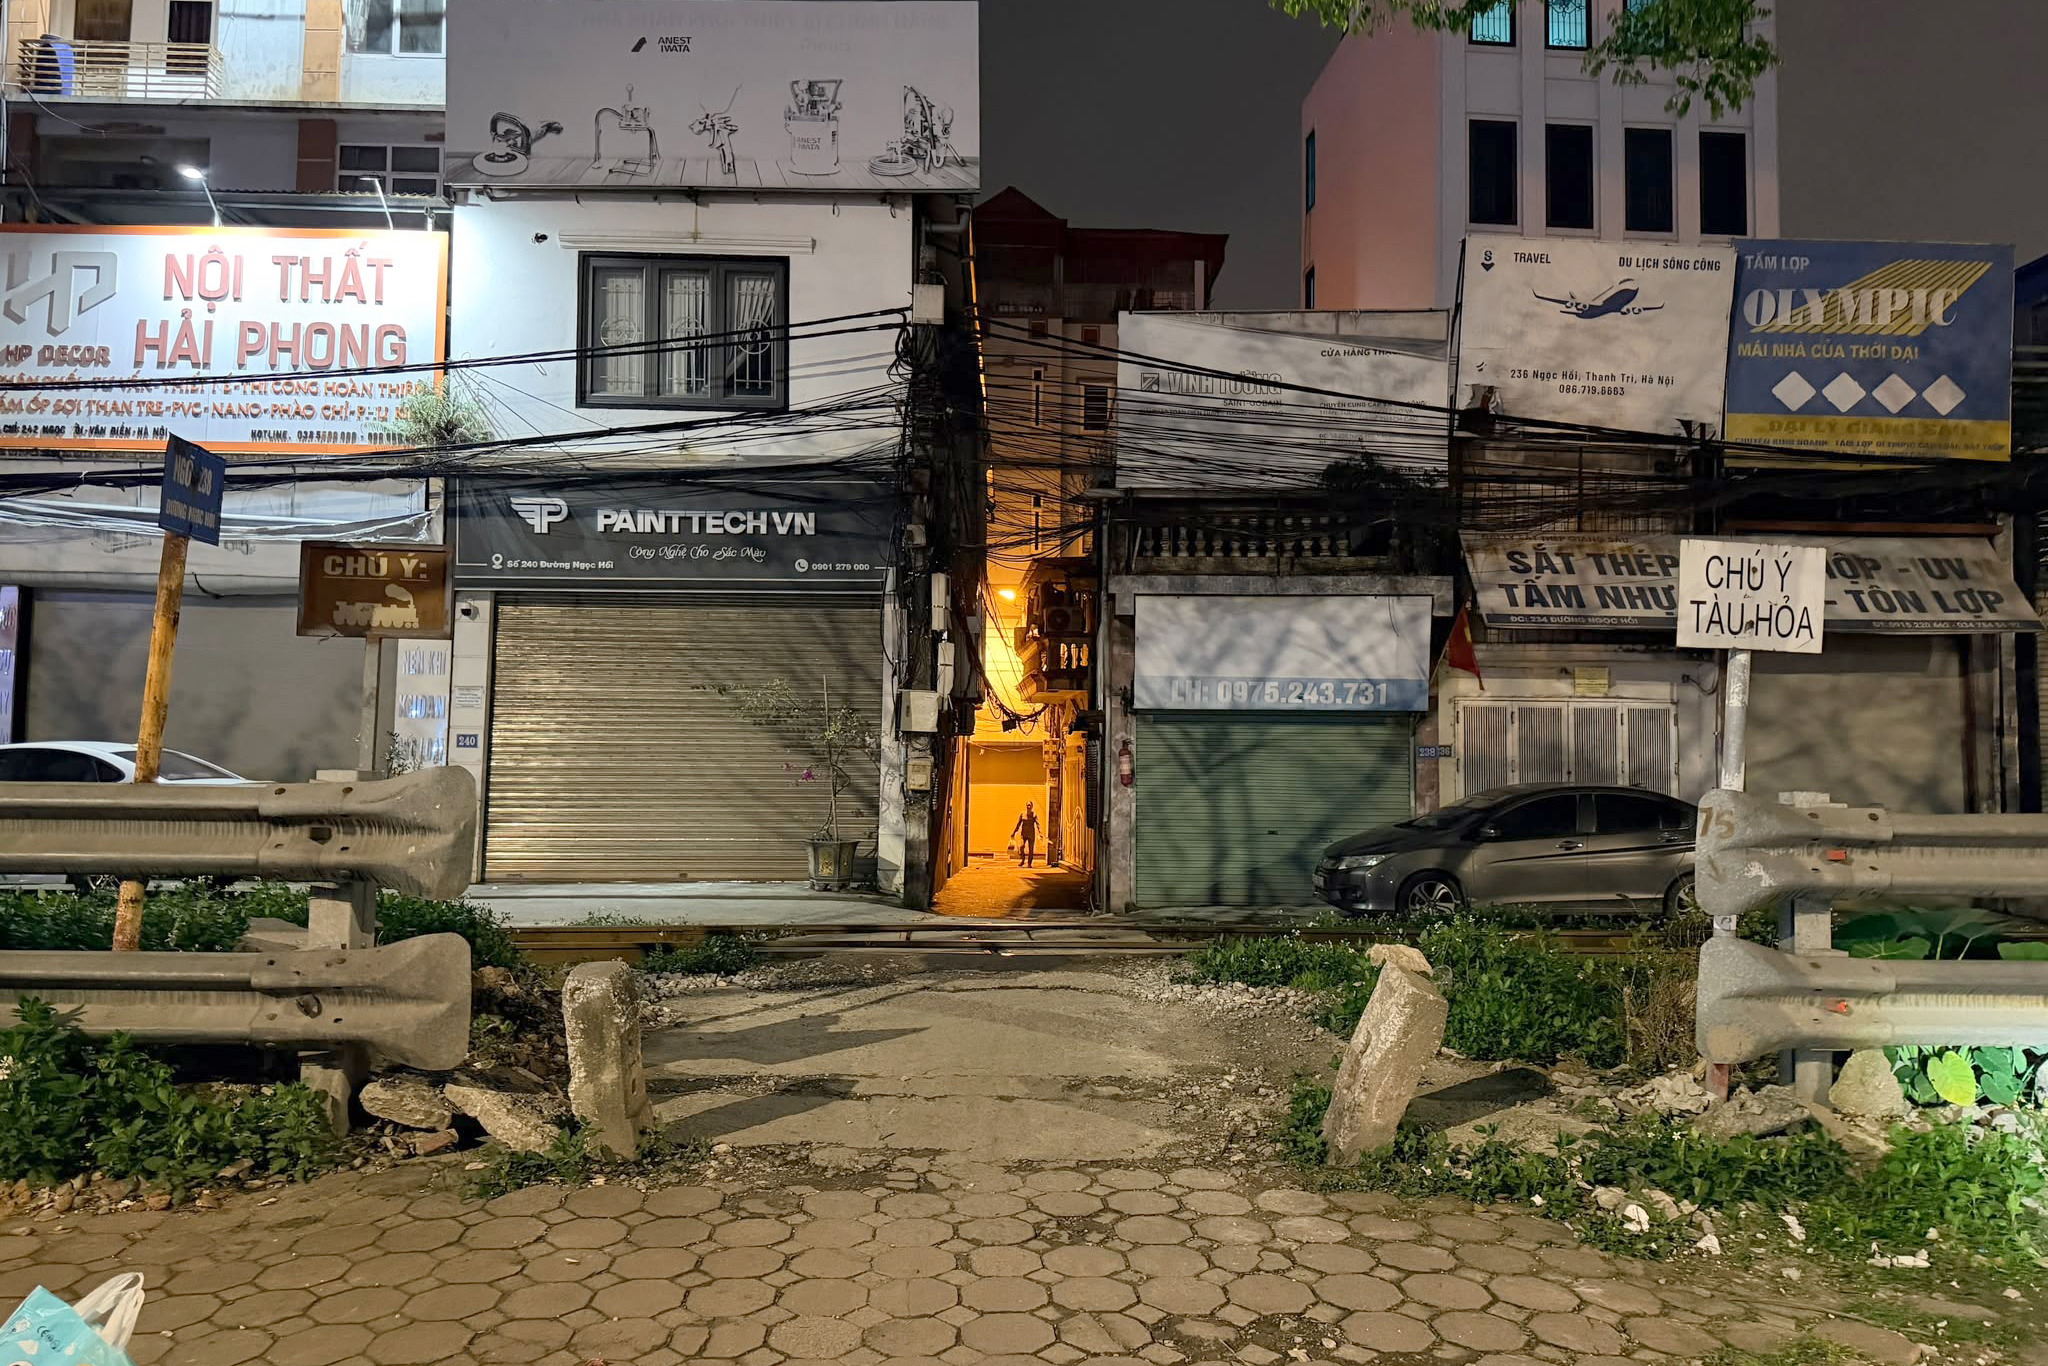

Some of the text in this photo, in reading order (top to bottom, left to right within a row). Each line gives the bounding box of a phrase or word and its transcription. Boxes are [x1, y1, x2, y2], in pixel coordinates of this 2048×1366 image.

[657, 36, 692, 45] ANEST
[660, 44, 690, 53] IWATA
[1513, 252, 1552, 265] TRAVEL
[1618, 256, 1722, 272] DU LỊCH SÔNG CÔNG
[1744, 250, 1811, 275] TẤM LỢP
[163, 240, 394, 313] NỘI THẤT
[1743, 287, 1959, 328] OLYMPIC
[133, 308, 408, 371] HẢI PHONG
[1737, 338, 1920, 364] MÁI NHÀ CỦA THỜI ĐẠI
[3, 344, 111, 368] HP DECOR
[1320, 346, 1342, 357] CỬA
[1343, 347, 1371, 357] HÀNG
[323, 377, 374, 399] HOÀN
[1510, 368, 1529, 380] 236
[1532, 369, 1558, 382] Ngọc
[1562, 369, 1582, 382] Hồi,
[1585, 371, 1617, 383] Thanh
[1641, 374, 1654, 385] Hà
[1657, 374, 1675, 388] Nội
[26, 391, 51, 415] ỐP
[52, 398, 84, 418] SỢI
[86, 399, 134, 419] THAN
[21, 424, 39, 435] 242
[41, 425, 66, 438] NGỌC
[322, 551, 428, 578] CHÚ Ý:
[507, 558, 614, 571] Số 240 Đường Ngọc Hồi
[629, 544, 766, 563] Công Nghệ Cho Sắc Màu
[1506, 543, 1576, 575] SẮT
[1586, 549, 1680, 577] THÉP
[1918, 557, 1969, 580] UV
[811, 562, 833, 572] 0901
[853, 563, 870, 572] 000
[1705, 549, 1793, 593] CHÚ Ý
[1498, 575, 1586, 609] TẤM
[1844, 584, 1929, 614] TÔN
[1931, 587, 2005, 619] LỢP
[1530, 616, 1549, 624] 234
[1690, 593, 1815, 640] TÀU HỎA
[1170, 679, 1388, 705] LH: 0975.243.731
[458, 735, 476, 747] 240
[1419, 747, 1436, 757] 238
[1699, 806, 1736, 839] 75
